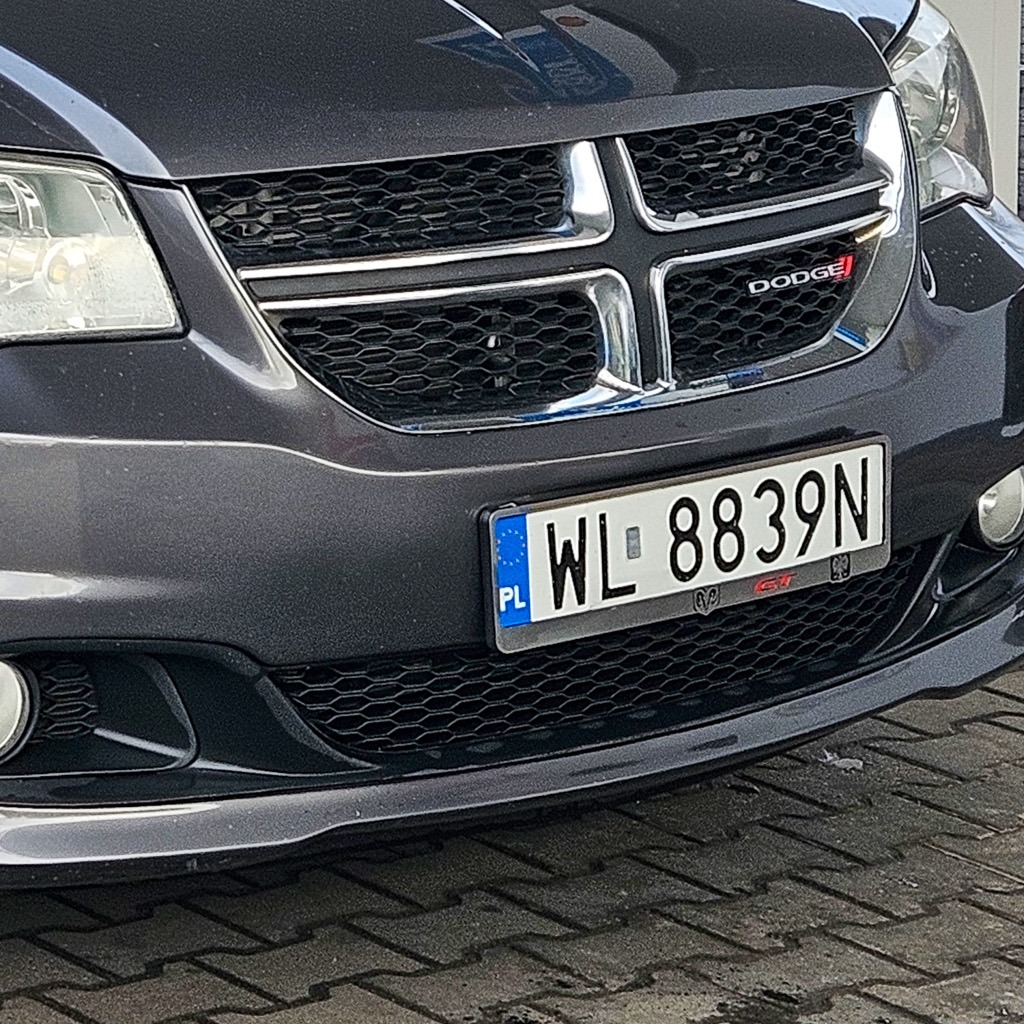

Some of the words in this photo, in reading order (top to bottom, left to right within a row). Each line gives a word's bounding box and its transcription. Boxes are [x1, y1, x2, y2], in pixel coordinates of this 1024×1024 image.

[748, 262, 845, 294] DODGE
[546, 512, 637, 611] WL
[668, 457, 868, 582] 8839N
[753, 573, 796, 593] GT
[499, 587, 526, 612] PL
